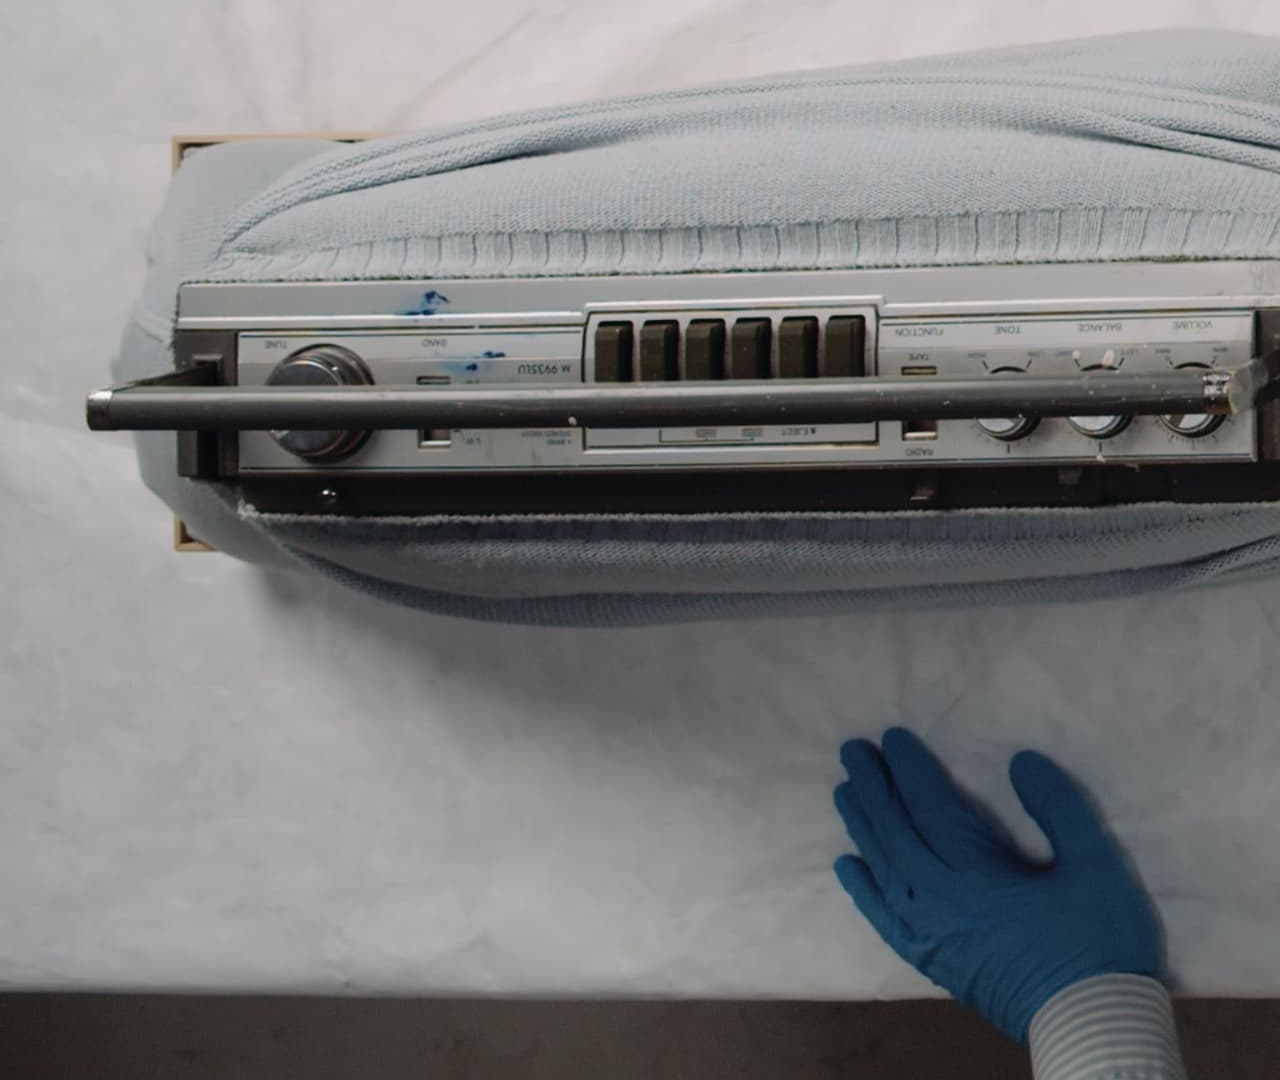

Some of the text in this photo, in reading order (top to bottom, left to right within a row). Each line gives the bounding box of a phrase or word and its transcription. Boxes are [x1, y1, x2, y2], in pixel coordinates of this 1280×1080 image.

[1078, 323, 1122, 332] BALANCE
[1172, 320, 1213, 330] VOLUME
[895, 328, 944, 336] FUNCTION
[994, 325, 1020, 335] TONE
[909, 353, 929, 361] TAPE
[904, 448, 934, 456] RADIO
